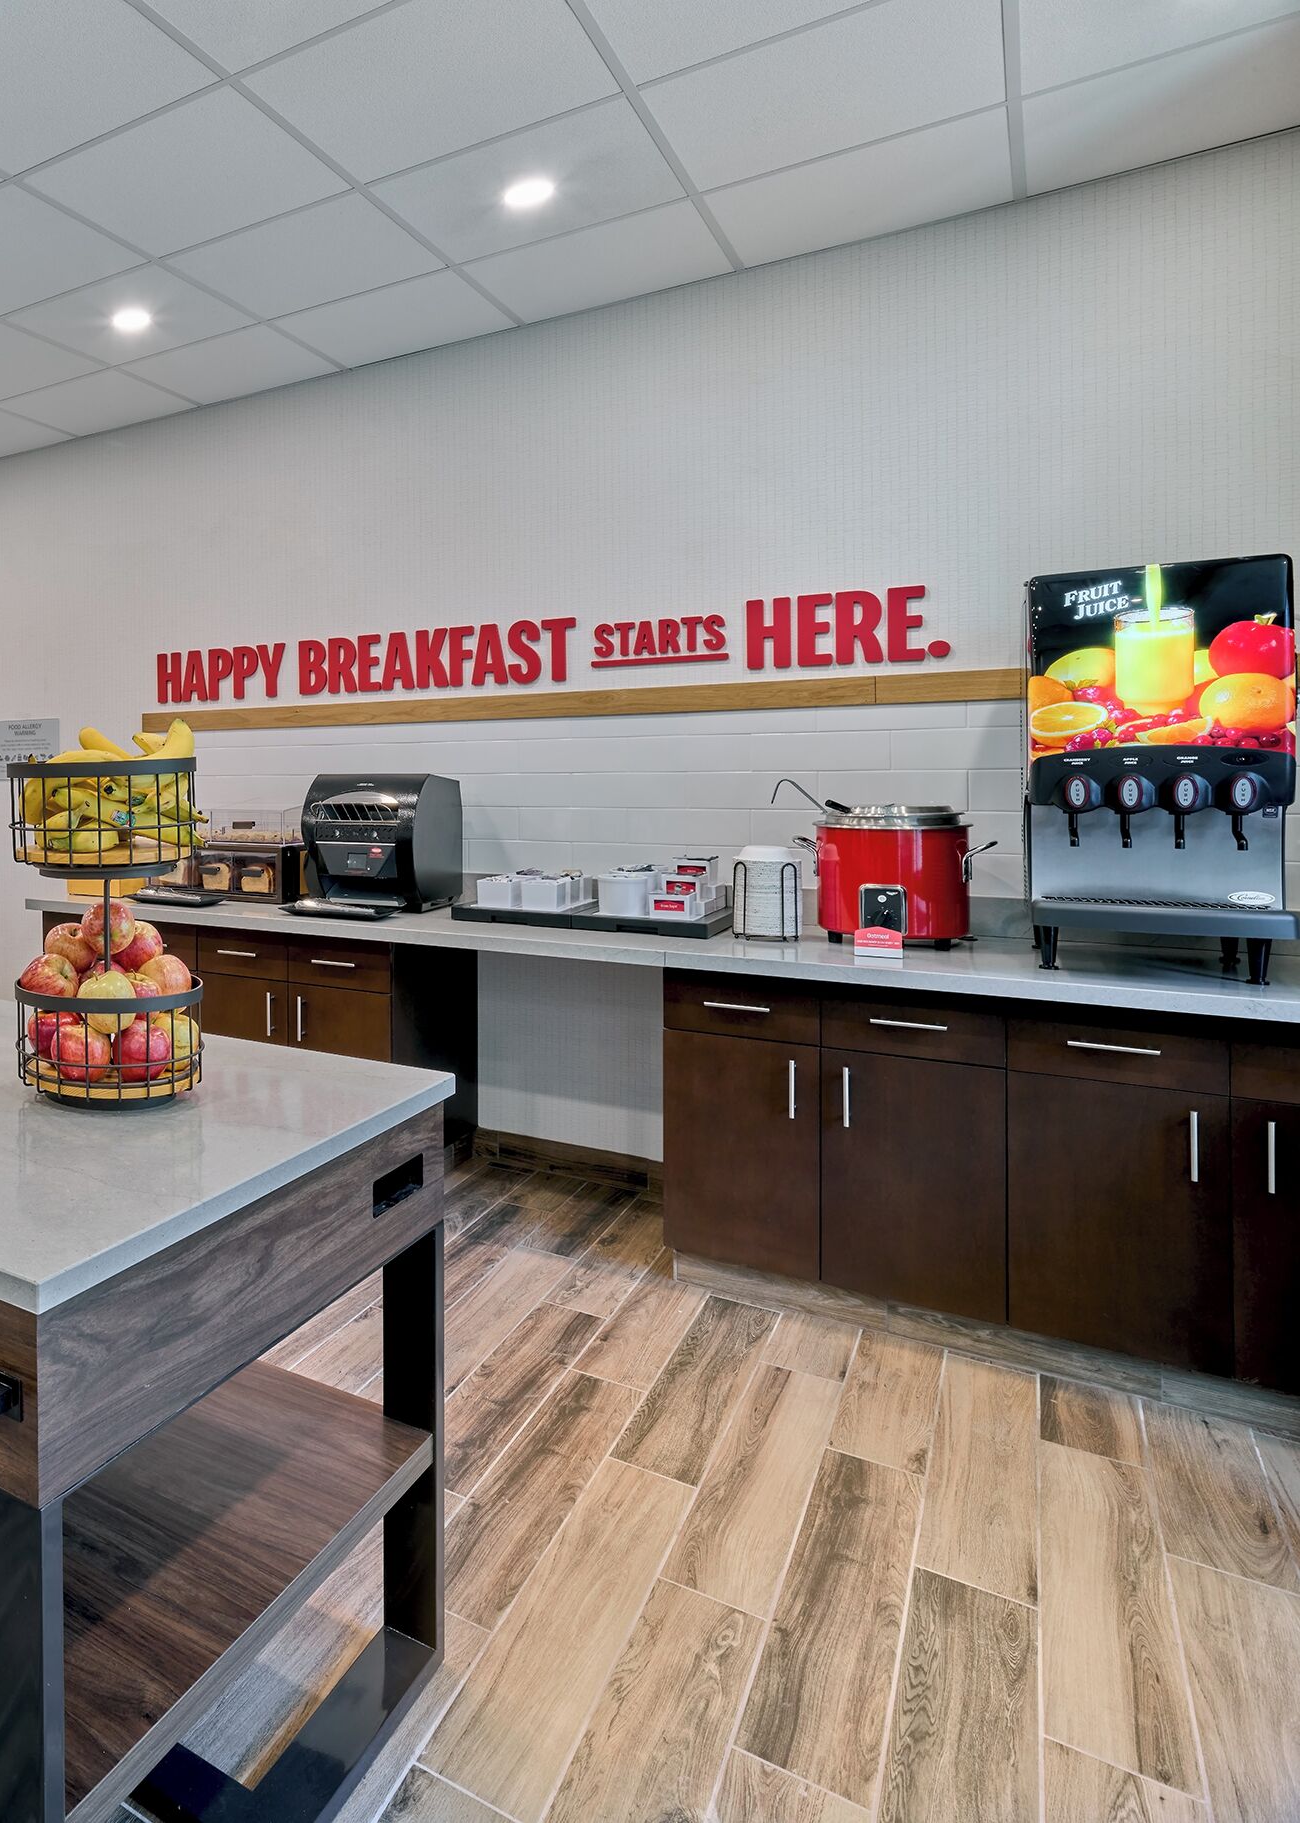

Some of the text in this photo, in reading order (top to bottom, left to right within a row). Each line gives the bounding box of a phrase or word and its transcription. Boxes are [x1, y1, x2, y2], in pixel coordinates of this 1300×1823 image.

[1063, 580, 1123, 607] FRUIT
[1073, 595, 1130, 620] JUICE
[156, 585, 952, 704] HAPPY BREAKFAST STARTS HERE.
